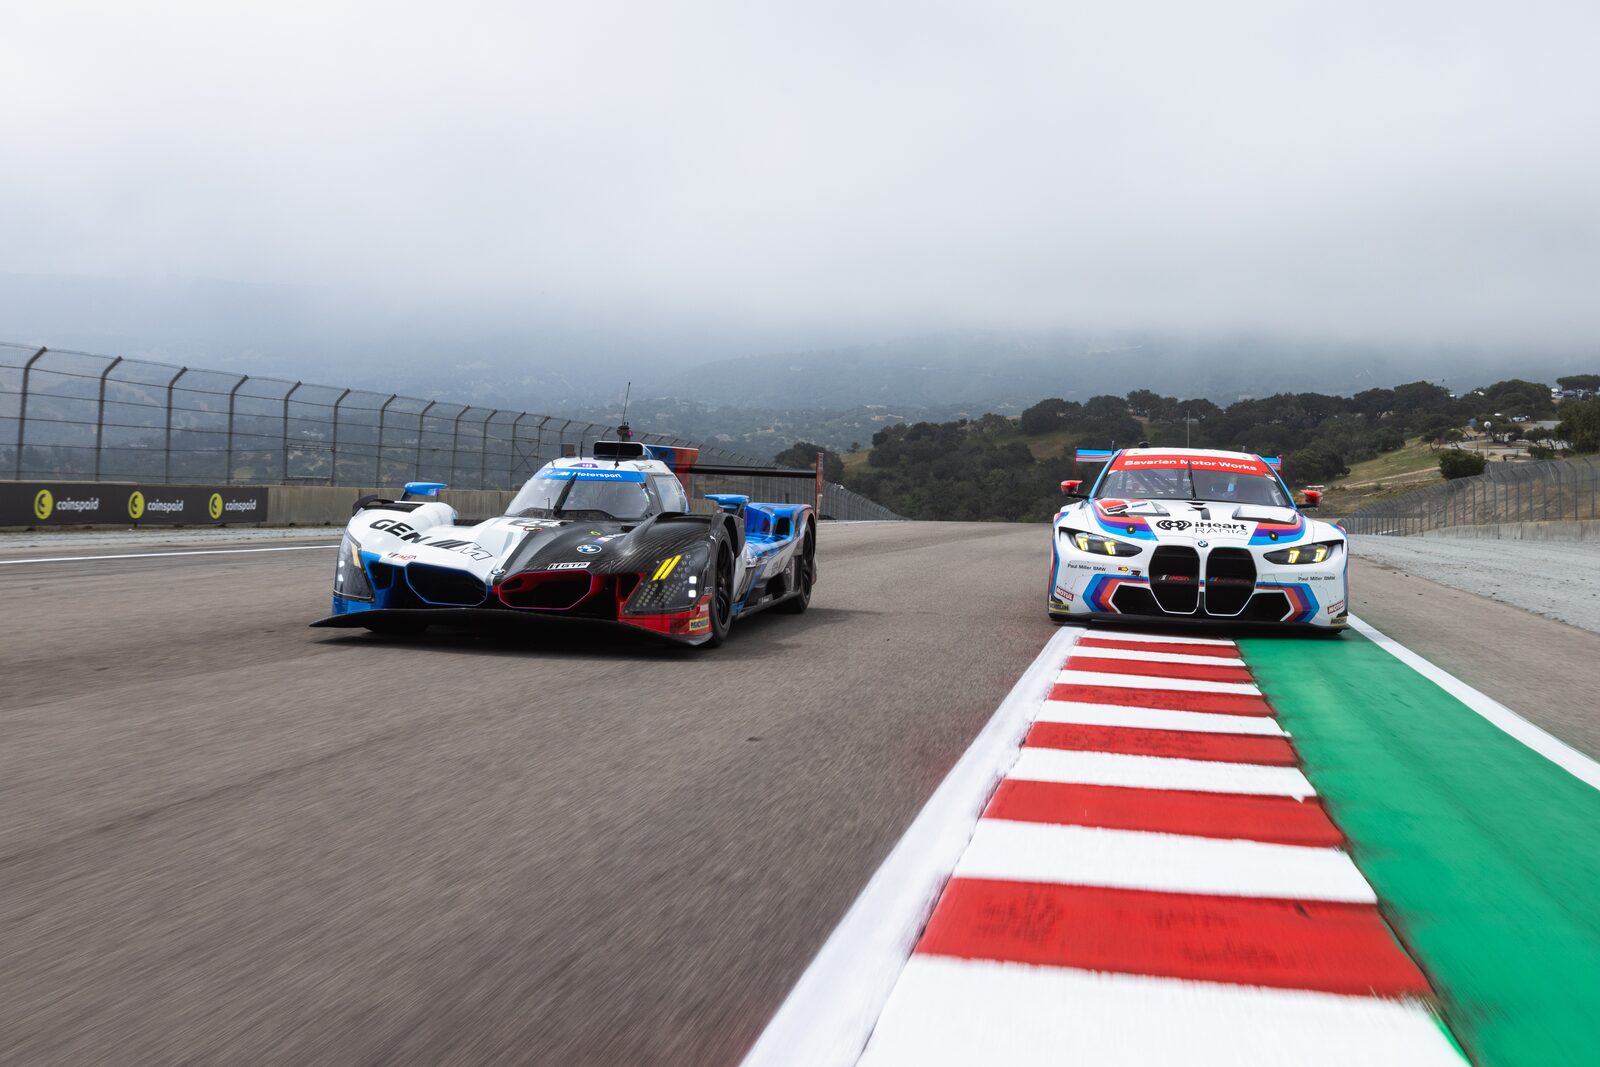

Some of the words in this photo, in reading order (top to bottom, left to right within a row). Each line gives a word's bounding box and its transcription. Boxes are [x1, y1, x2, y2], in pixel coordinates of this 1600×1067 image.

[1217, 461, 1258, 471] Works
[56, 497, 99, 511] coinspaid
[147, 499, 183, 512] coinspaid
[225, 499, 257, 511] coinspaid
[369, 519, 432, 544] GEN
[1195, 521, 1247, 530] iHeart
[1056, 587, 1073, 600] MOTUL
